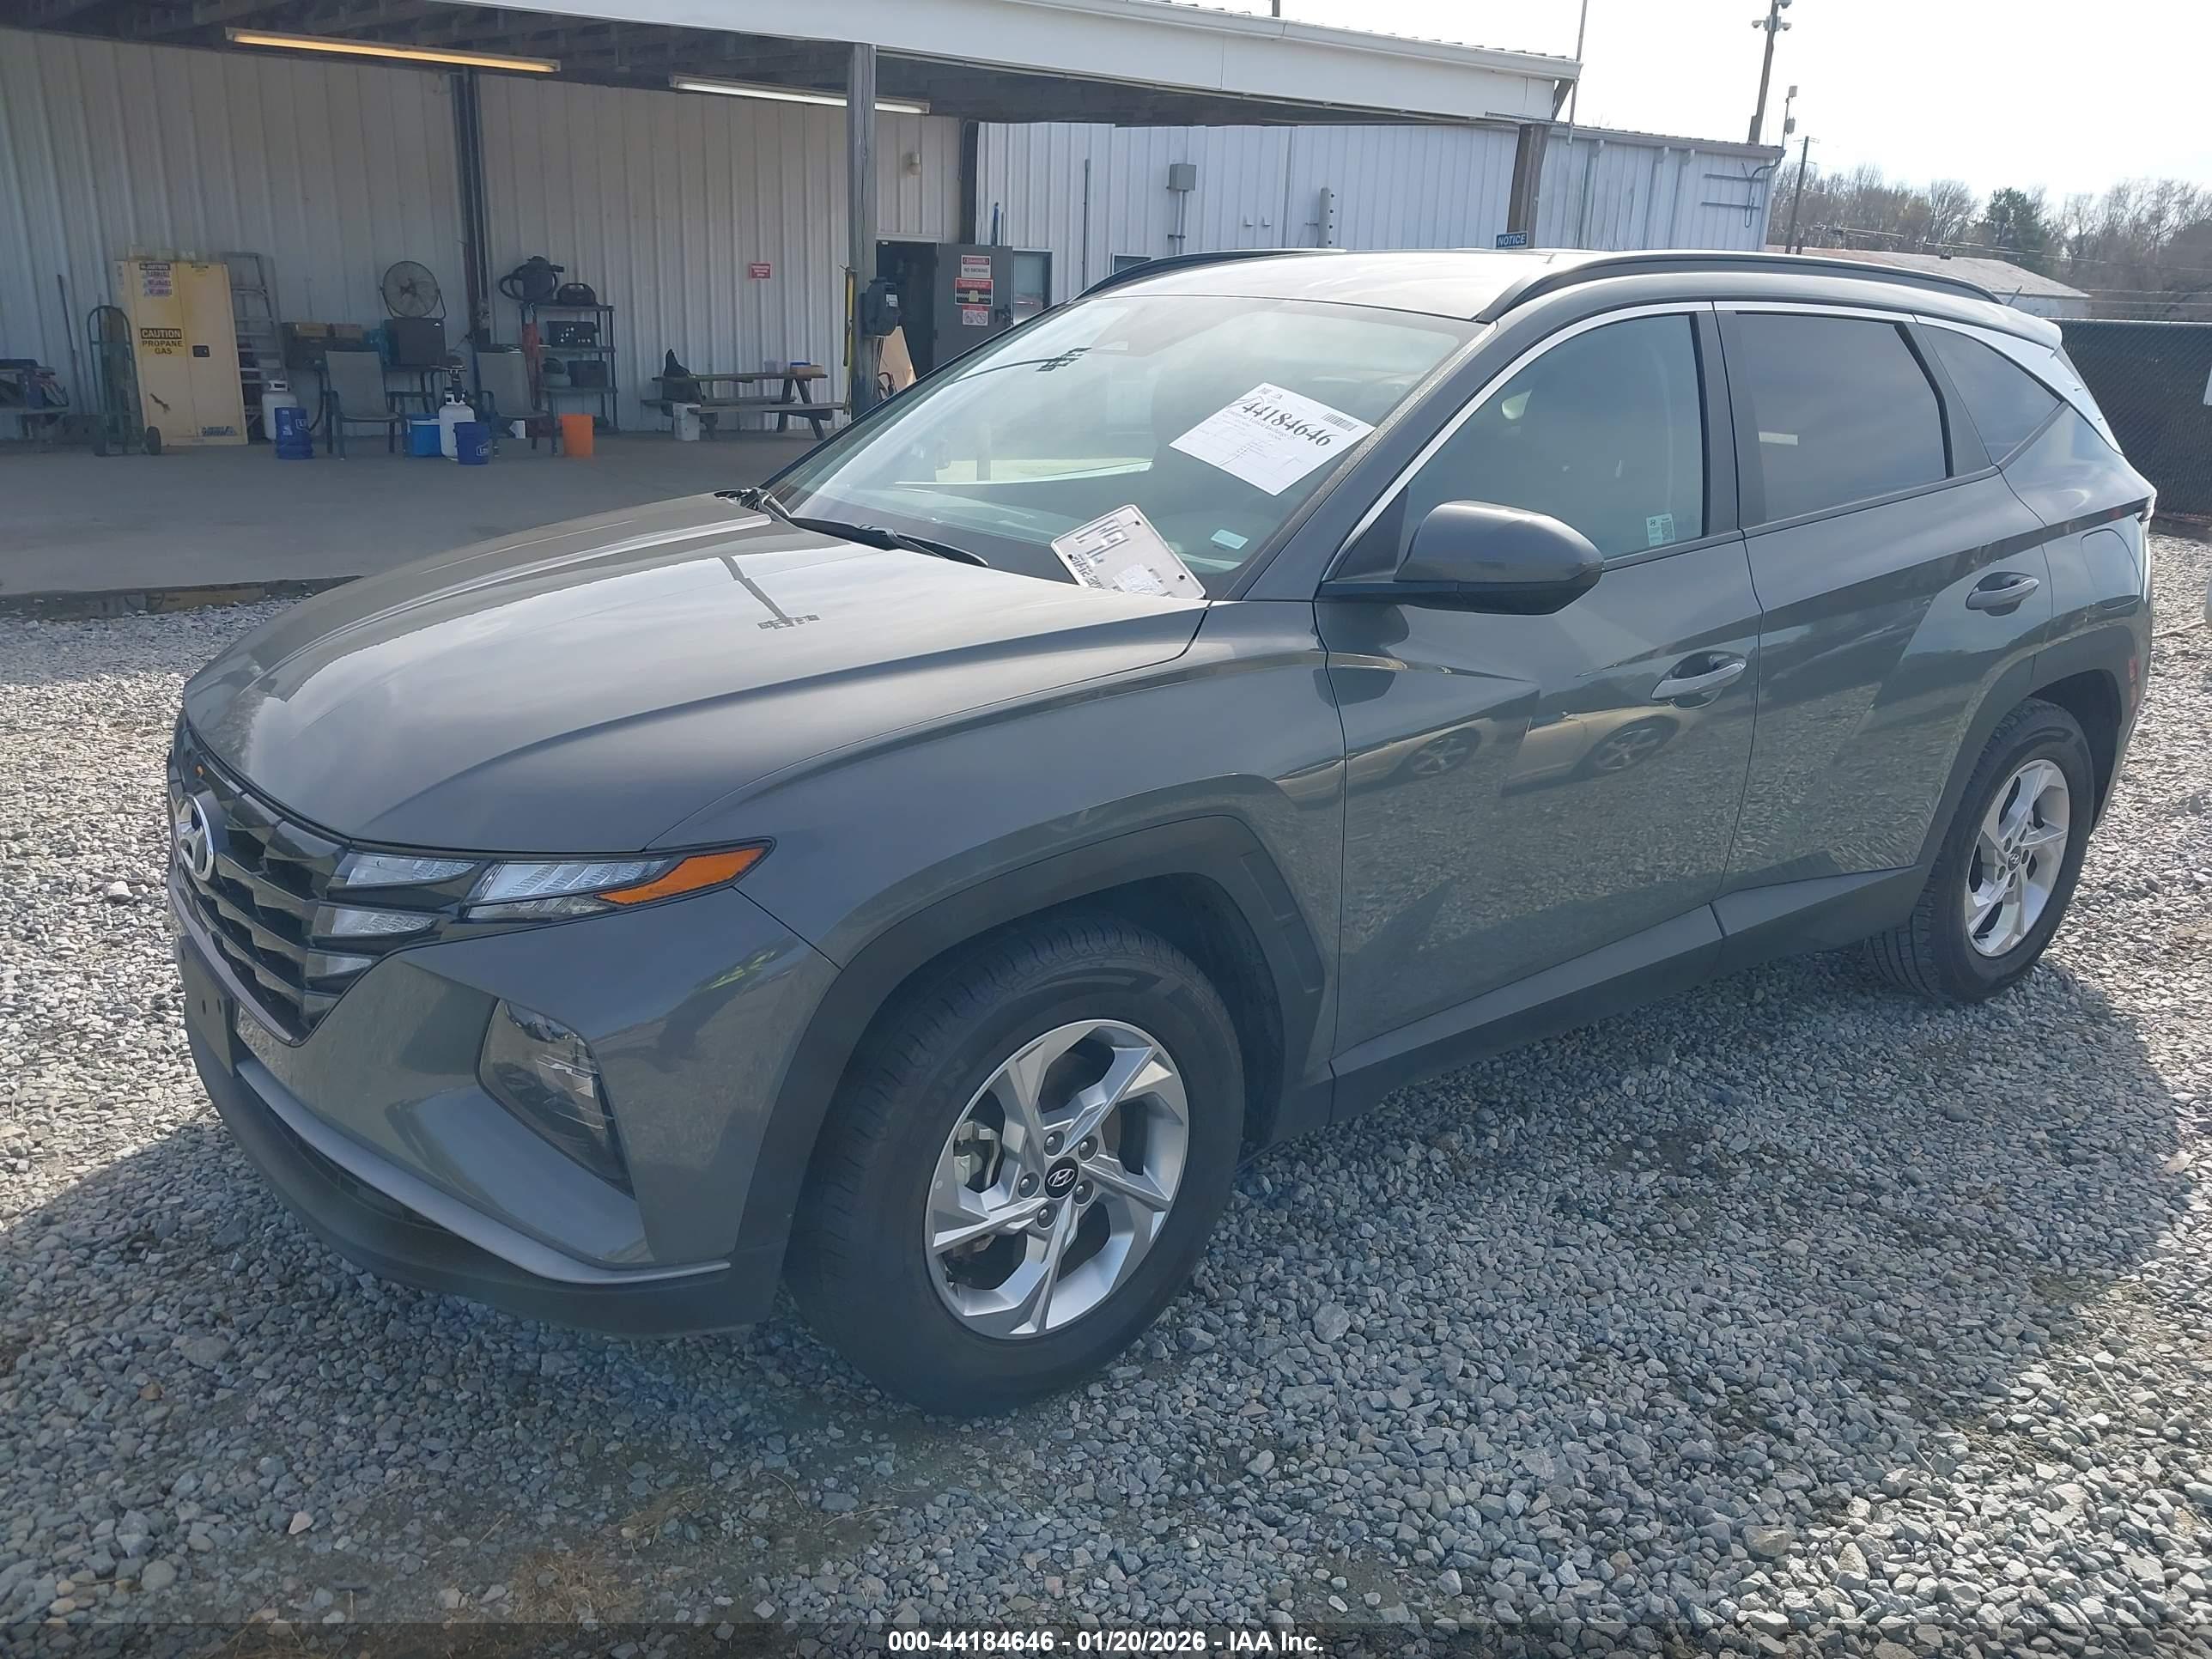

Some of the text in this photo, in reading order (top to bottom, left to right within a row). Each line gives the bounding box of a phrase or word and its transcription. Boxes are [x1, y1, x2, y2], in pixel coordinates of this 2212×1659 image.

[1498, 234, 1526, 246] NOTICE
[142, 330, 180, 338] CAUTION
[1243, 401, 1340, 447] 44184646
